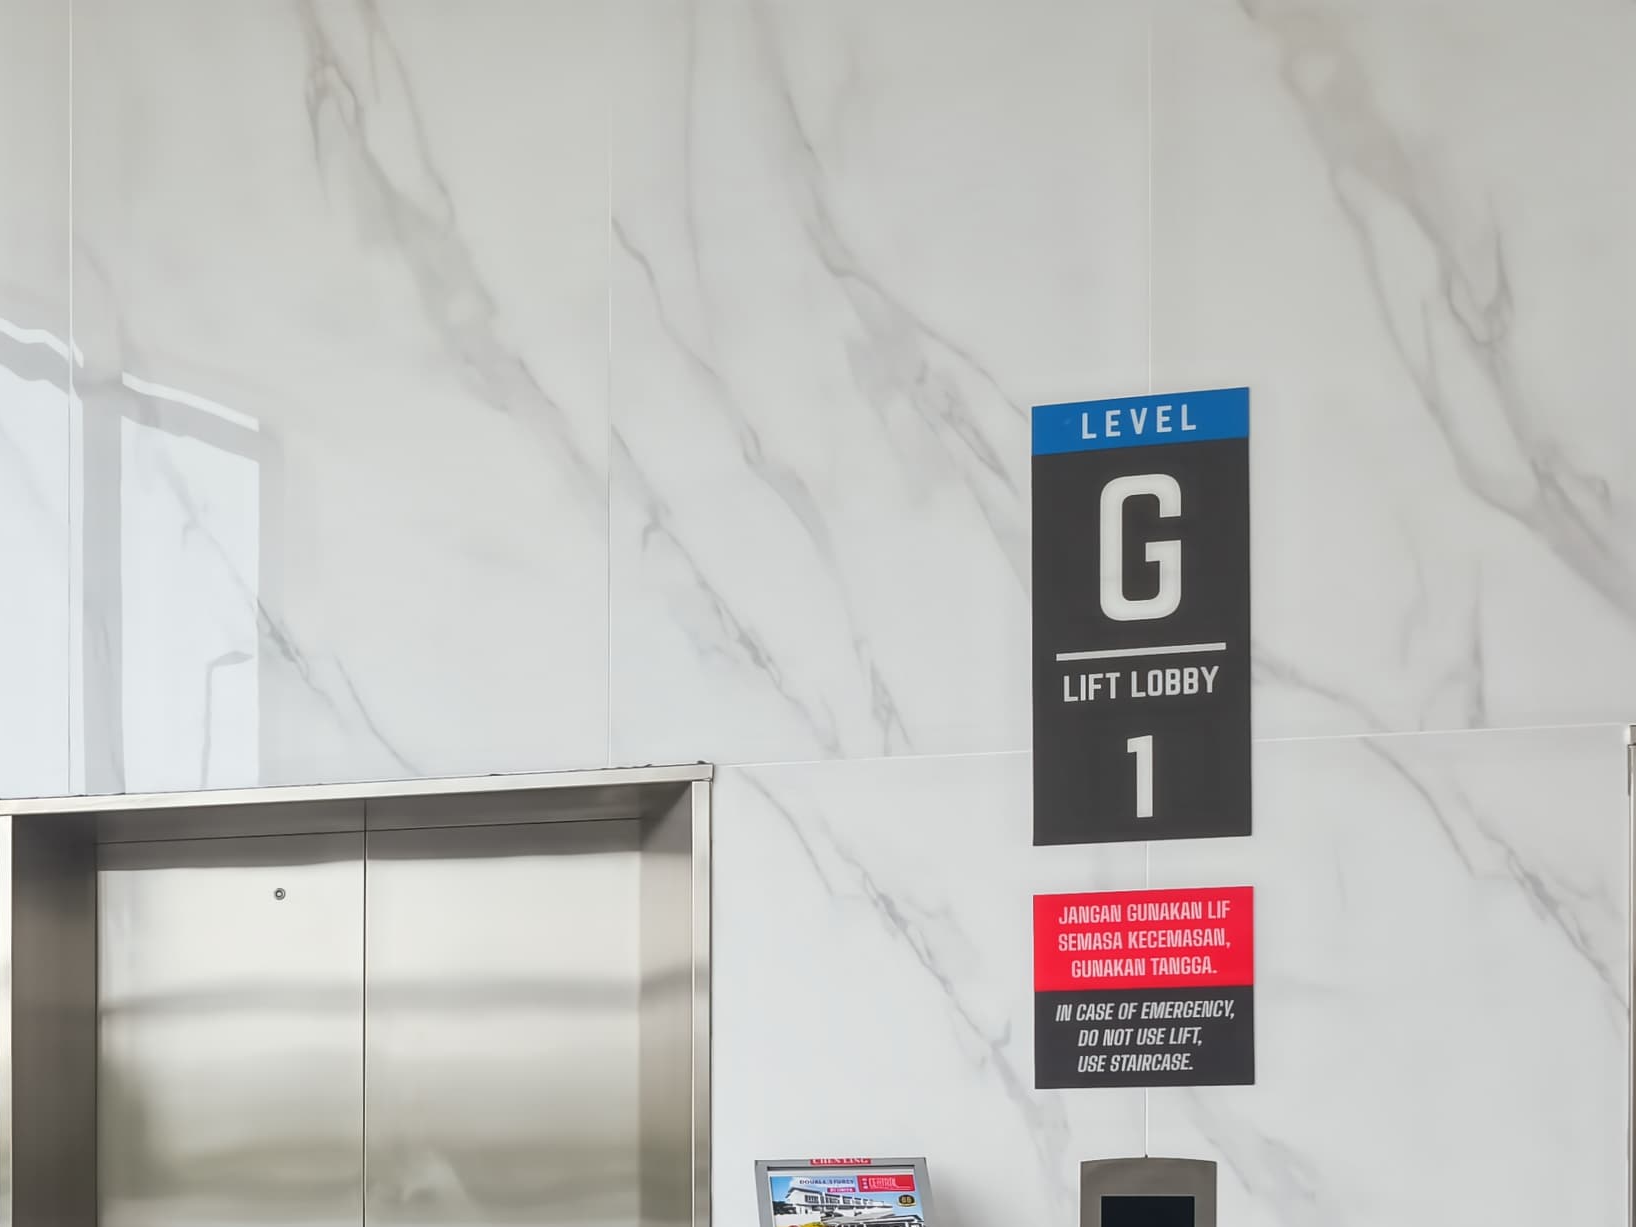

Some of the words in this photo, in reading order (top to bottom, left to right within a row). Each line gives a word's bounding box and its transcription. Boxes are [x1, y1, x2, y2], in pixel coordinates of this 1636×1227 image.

[1081, 404, 1197, 439] LEVEL
[1100, 473, 1181, 621] G
[1064, 672, 1121, 702] LIFT
[1131, 666, 1219, 698] LOBBY
[1127, 735, 1153, 818] 1
[1058, 904, 1121, 925] JANGAN
[1127, 901, 1202, 922] GUNAKAN
[1207, 900, 1231, 920] LIF
[1058, 931, 1123, 951] SEMASA
[1128, 928, 1231, 949] KECEMASAN,
[1071, 958, 1146, 978] GUNAKAN
[1150, 956, 1218, 975] TANGGA.
[1055, 1004, 1073, 1022] IN
[1076, 1003, 1115, 1021] CASE
[1117, 1002, 1138, 1020] OF
[1140, 1000, 1235, 1020] EMERGENCY,
[1078, 1029, 1099, 1047] DO
[1102, 1028, 1134, 1046] NOT
[1136, 1028, 1166, 1045] USE
[1169, 1027, 1202, 1047] LIFT,
[1077, 1055, 1107, 1073] USE
[1110, 1053, 1194, 1072] STAIRCASE.
